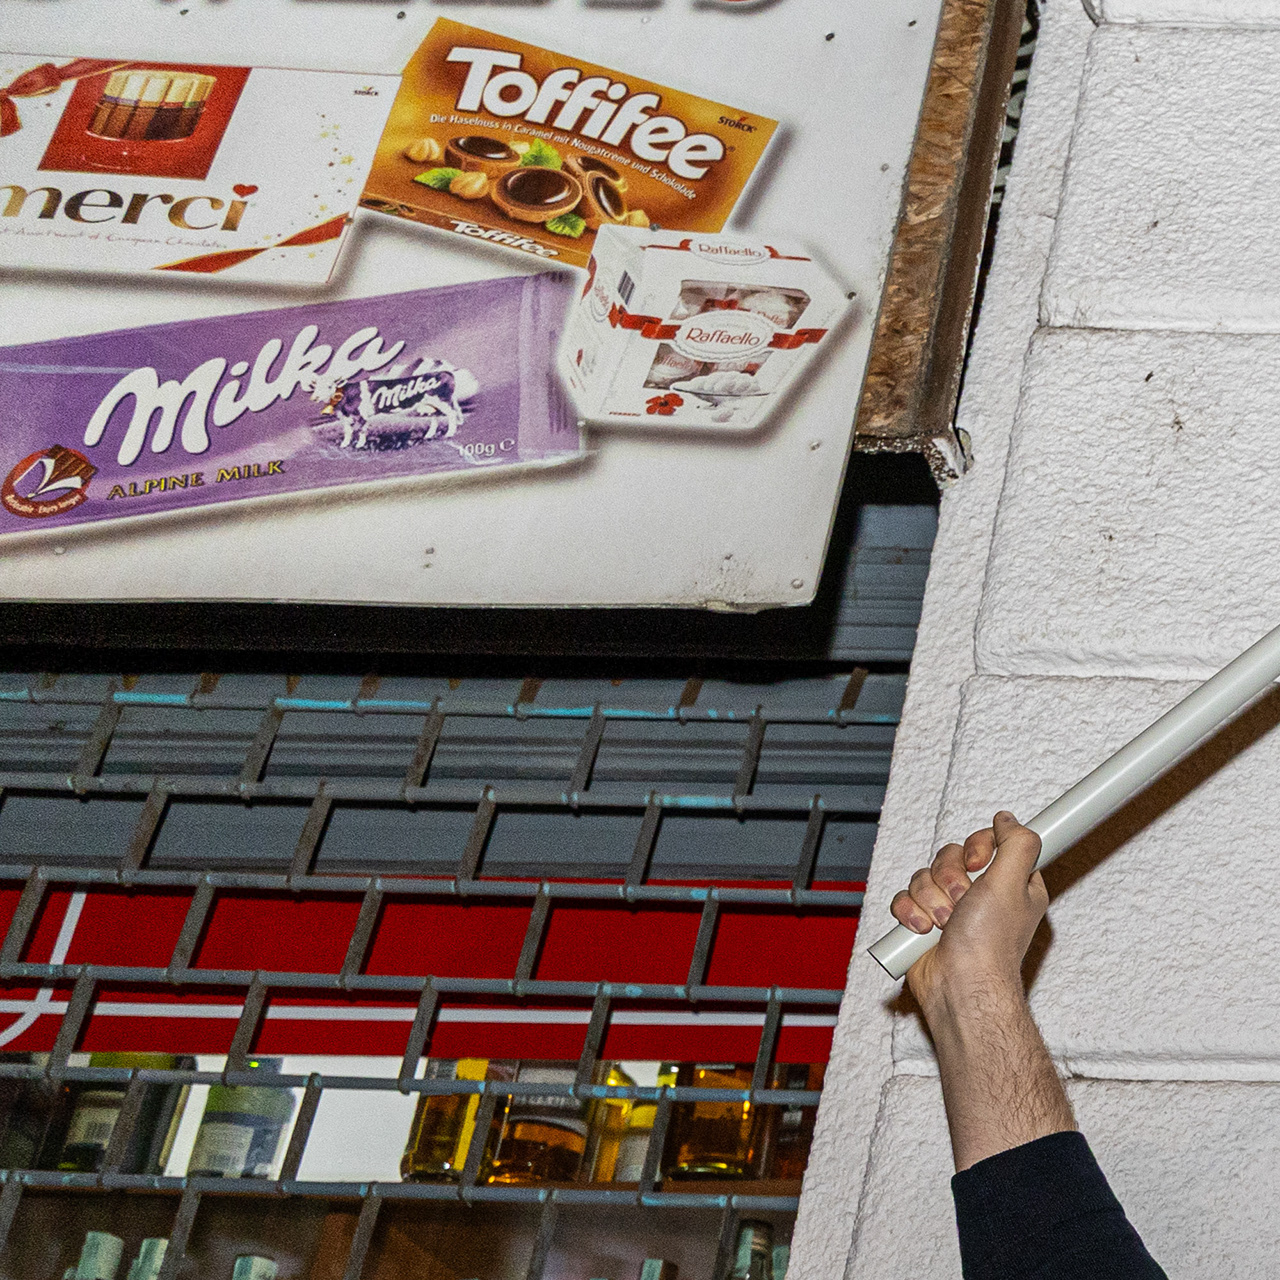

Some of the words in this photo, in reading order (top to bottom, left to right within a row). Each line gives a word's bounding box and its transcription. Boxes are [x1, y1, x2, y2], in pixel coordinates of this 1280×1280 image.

[445, 46, 727, 180] Toffifee
[450, 115, 499, 129] Haselnuss
[502, 122, 512, 131] in
[514, 124, 553, 139] Caramel
[571, 138, 631, 167] Nougatcreme
[632, 161, 651, 174] und
[650, 168, 697, 200] Schokolade
[0, 183, 258, 232] merci
[450, 219, 559, 257] Toffifee
[685, 327, 761, 348] Raffaello
[83, 325, 405, 467] Milka
[371, 375, 442, 409] Milka
[106, 472, 204, 502] ALPINE
[216, 458, 285, 482] MILK
